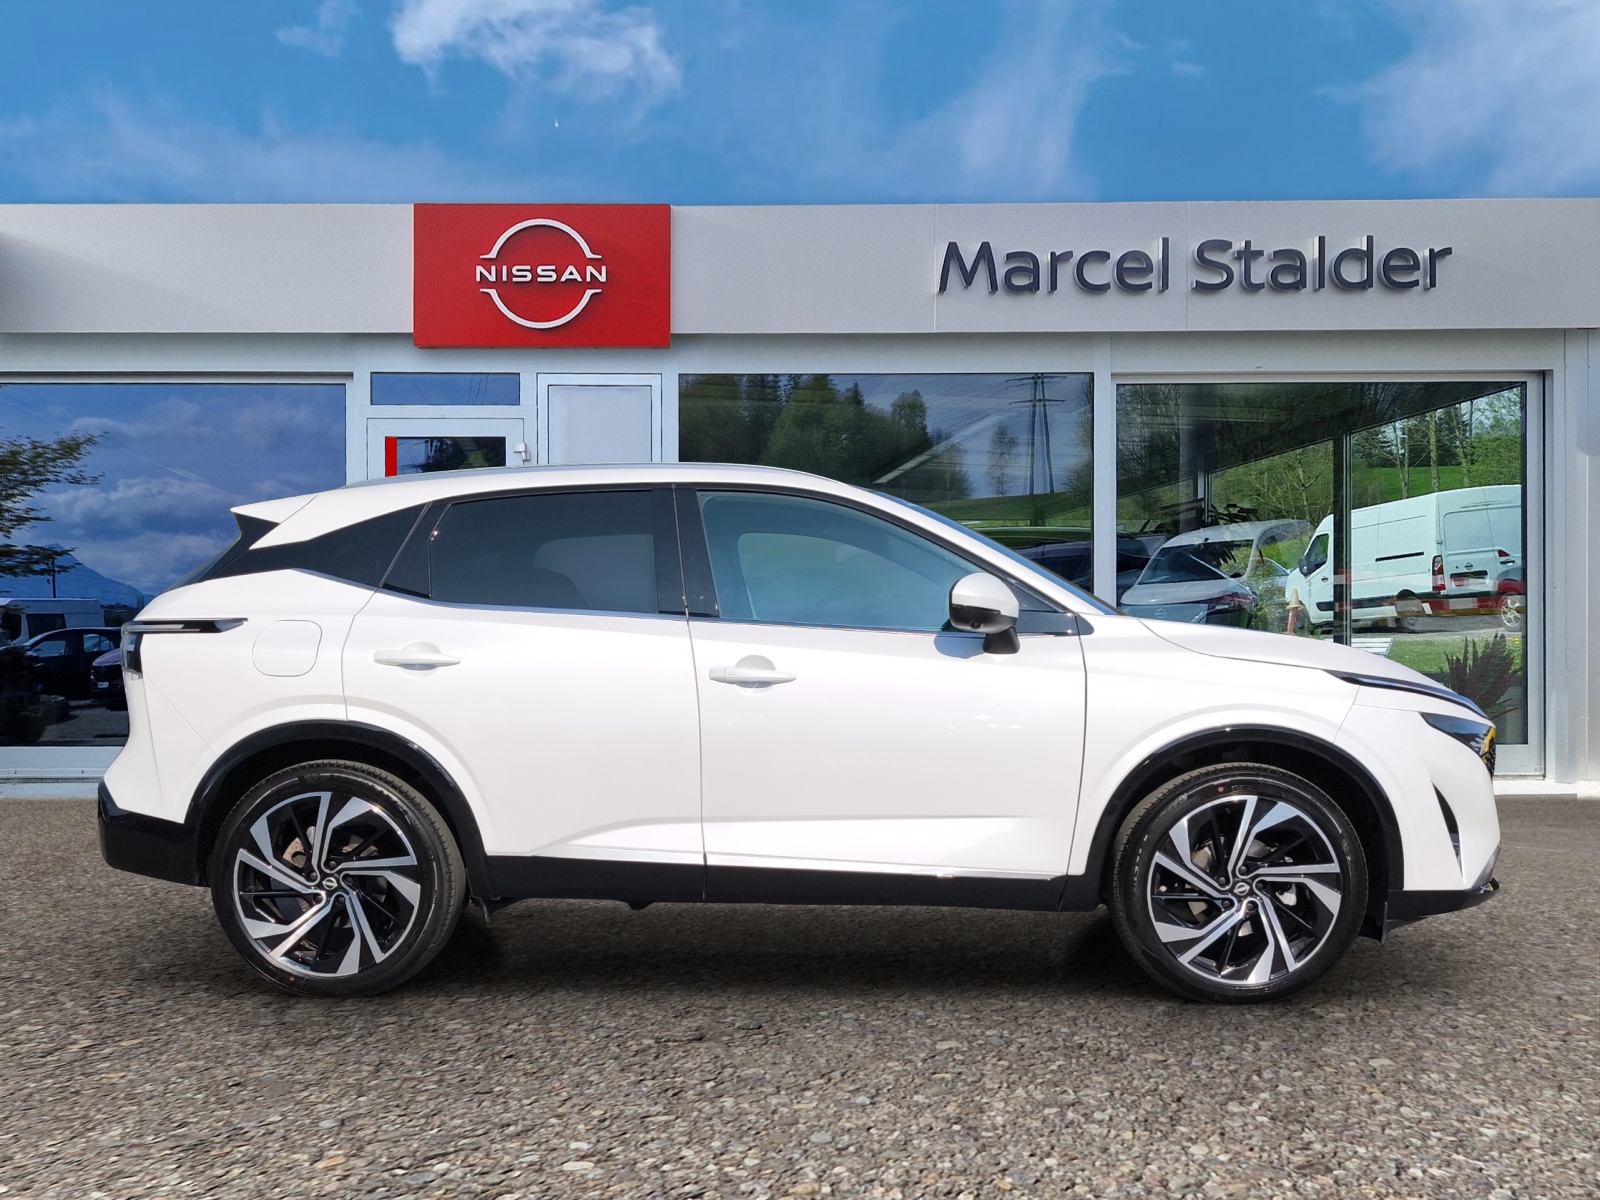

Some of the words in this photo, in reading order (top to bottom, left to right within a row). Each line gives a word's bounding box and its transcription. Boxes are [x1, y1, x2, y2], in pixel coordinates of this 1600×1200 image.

[475, 265, 607, 283] NISSAN
[938, 237, 1170, 294] Marcel
[1192, 235, 1453, 293] Stalder
